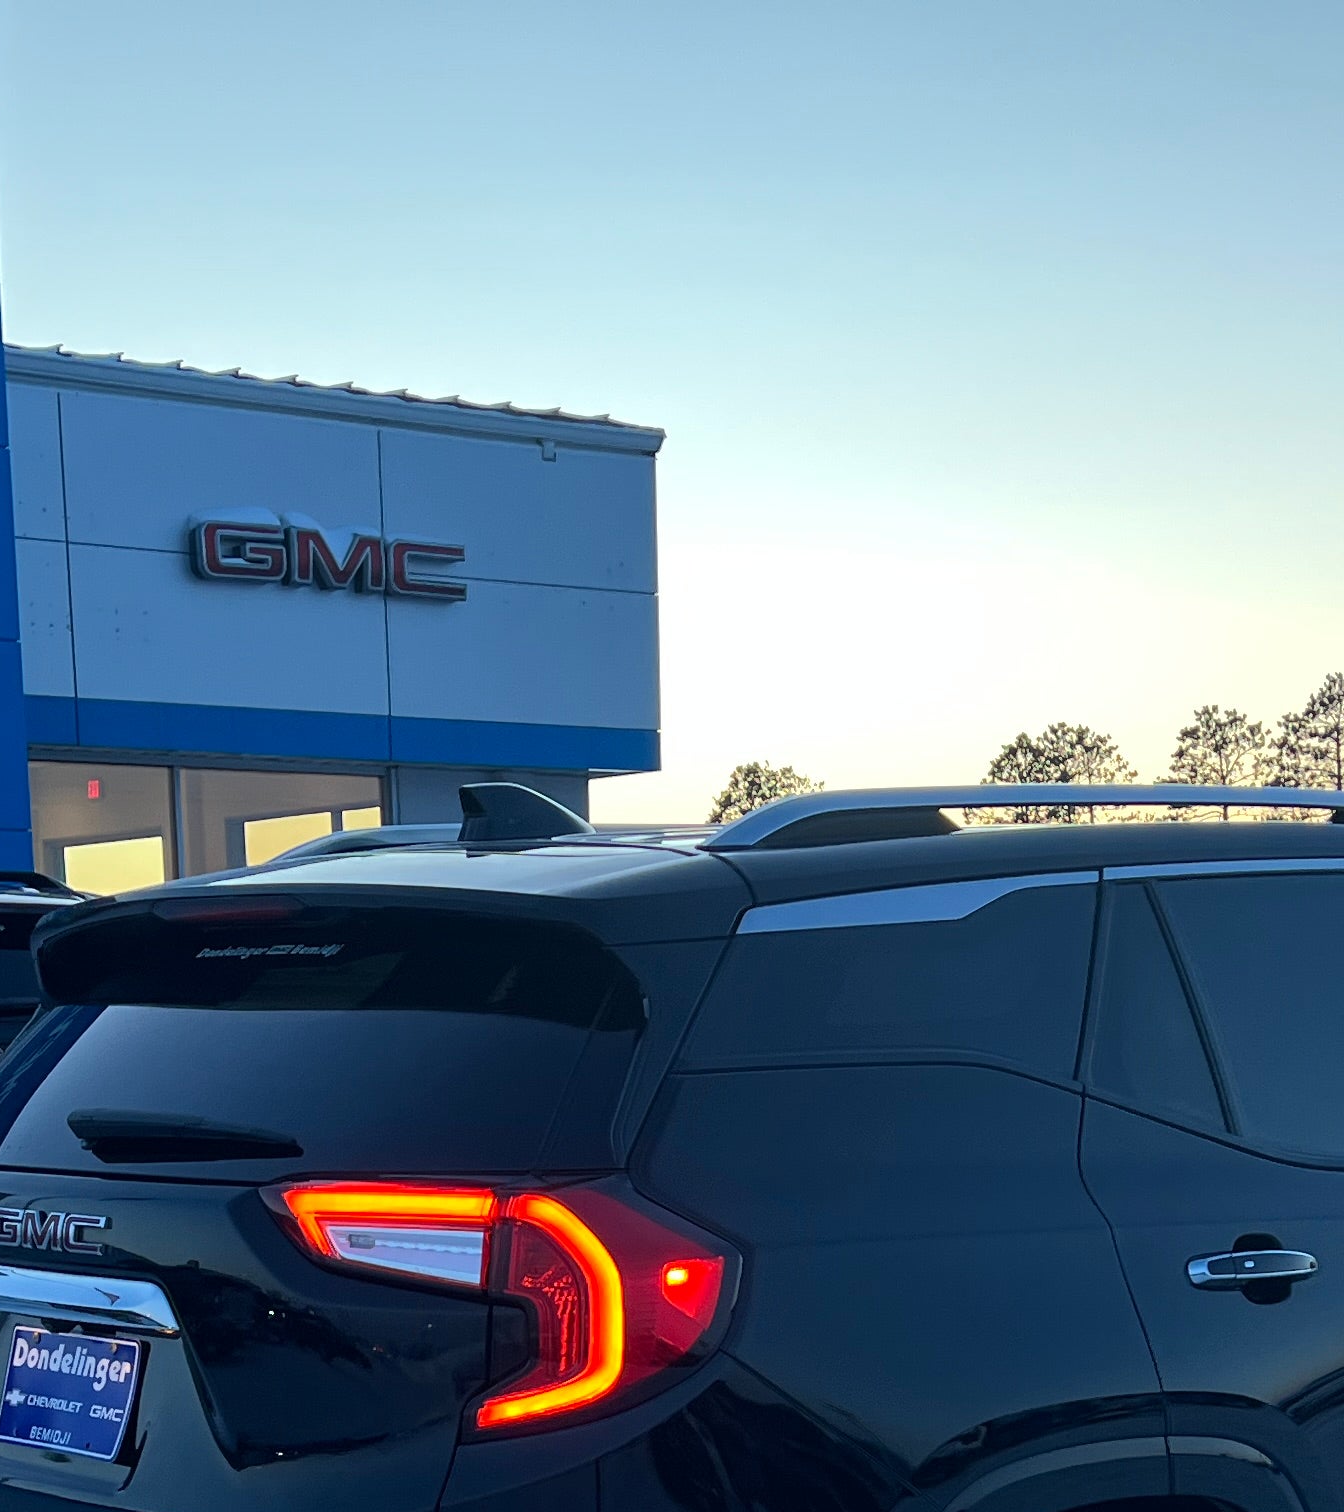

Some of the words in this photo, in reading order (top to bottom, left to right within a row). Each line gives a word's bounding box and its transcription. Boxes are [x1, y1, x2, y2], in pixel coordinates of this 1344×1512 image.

[189, 517, 467, 602] GMC
[12, 1338, 132, 1392] Dondelinger
[27, 1394, 83, 1414] CHEVROLET
[89, 1404, 126, 1422] GMC
[29, 1425, 72, 1446] BEMIDJI
